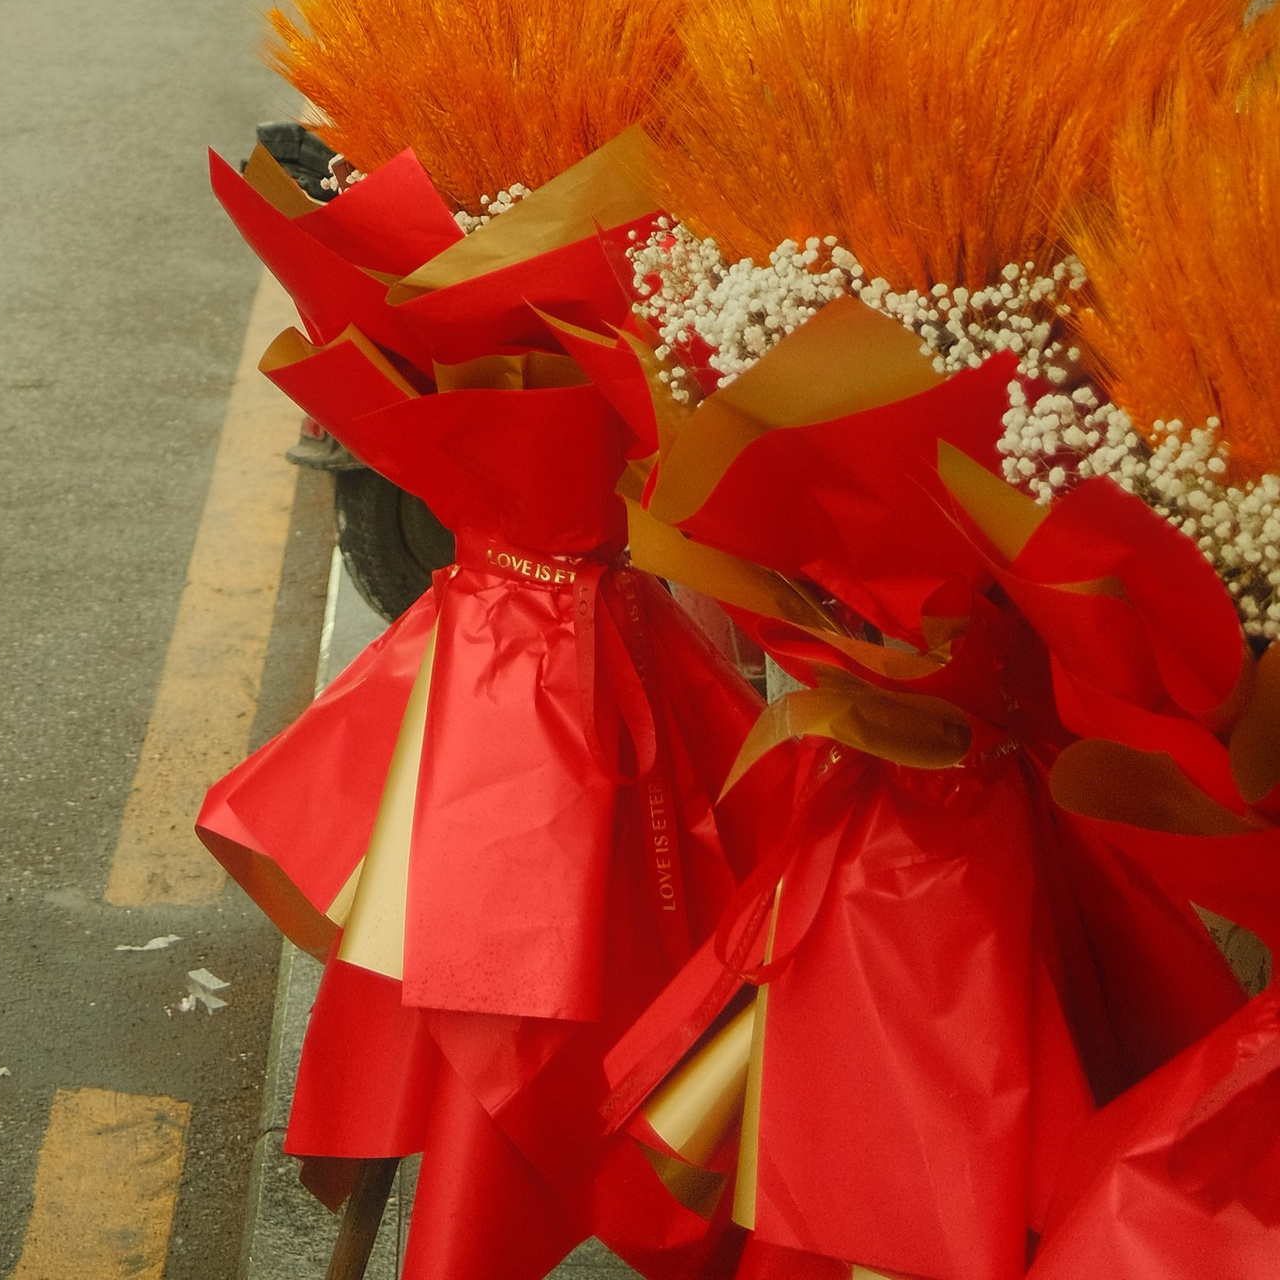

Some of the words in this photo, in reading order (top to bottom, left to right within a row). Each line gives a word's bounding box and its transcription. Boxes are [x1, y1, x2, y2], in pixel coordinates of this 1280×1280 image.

[486, 549, 533, 577] LOVE
[534, 563, 552, 583] IS
[653, 834, 669, 855] IS
[656, 857, 677, 912] LOVE
